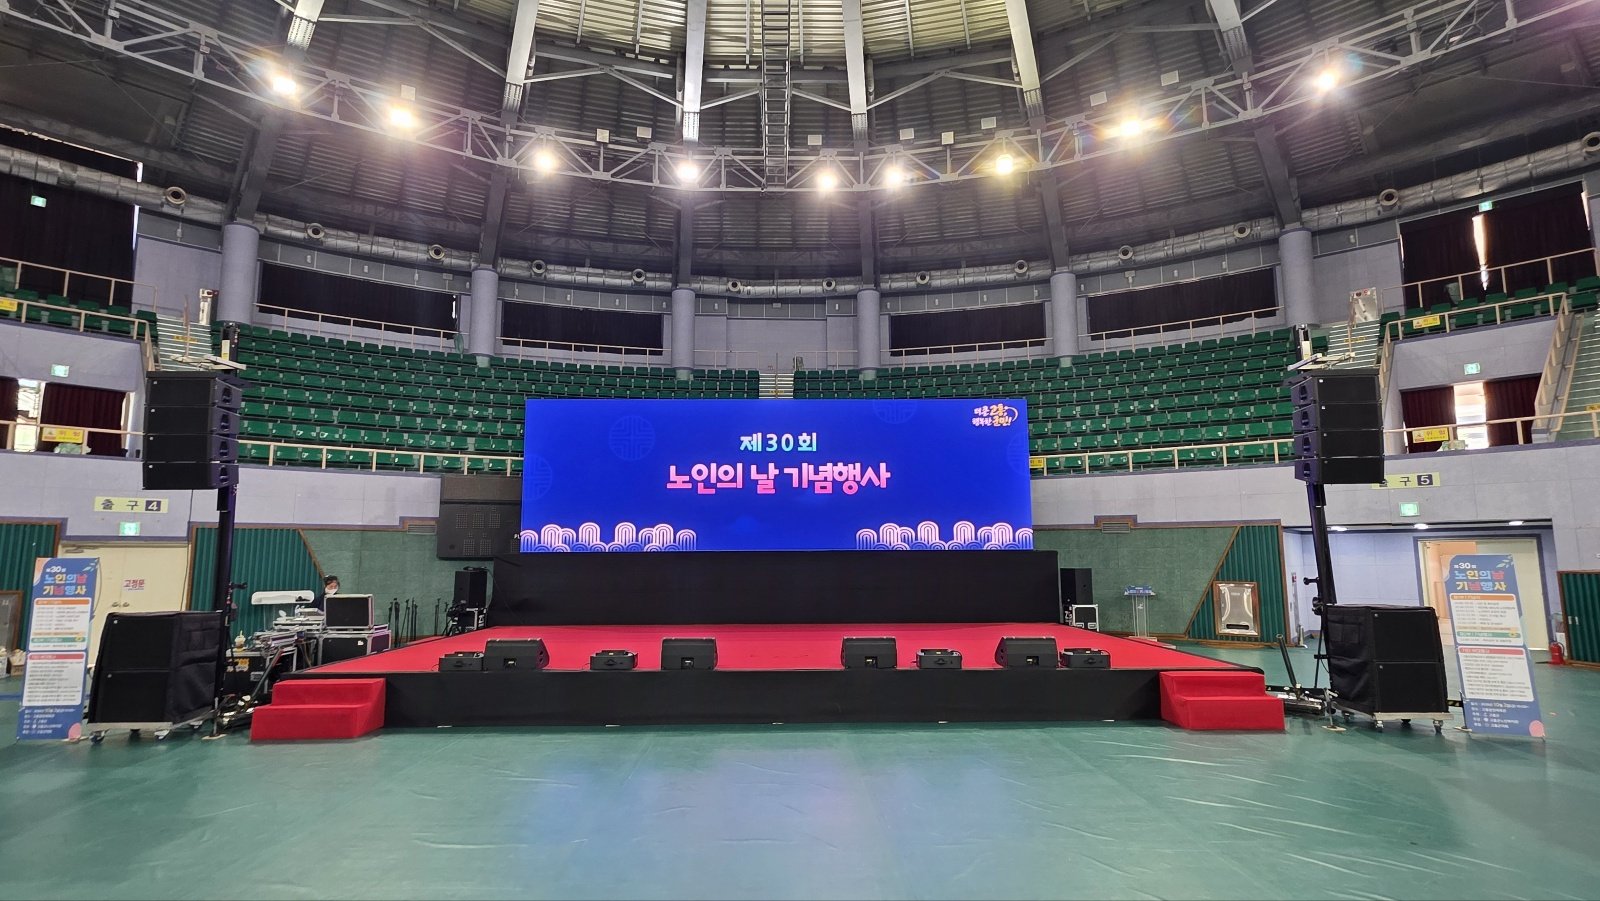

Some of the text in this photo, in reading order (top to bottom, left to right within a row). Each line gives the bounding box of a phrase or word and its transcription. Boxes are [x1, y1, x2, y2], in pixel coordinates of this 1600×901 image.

[740, 432, 817, 452] 제30회
[666, 462, 891, 495] 노인의 날 기념행사
[1420, 475, 1430, 485] 5
[147, 500, 158, 511] 4
